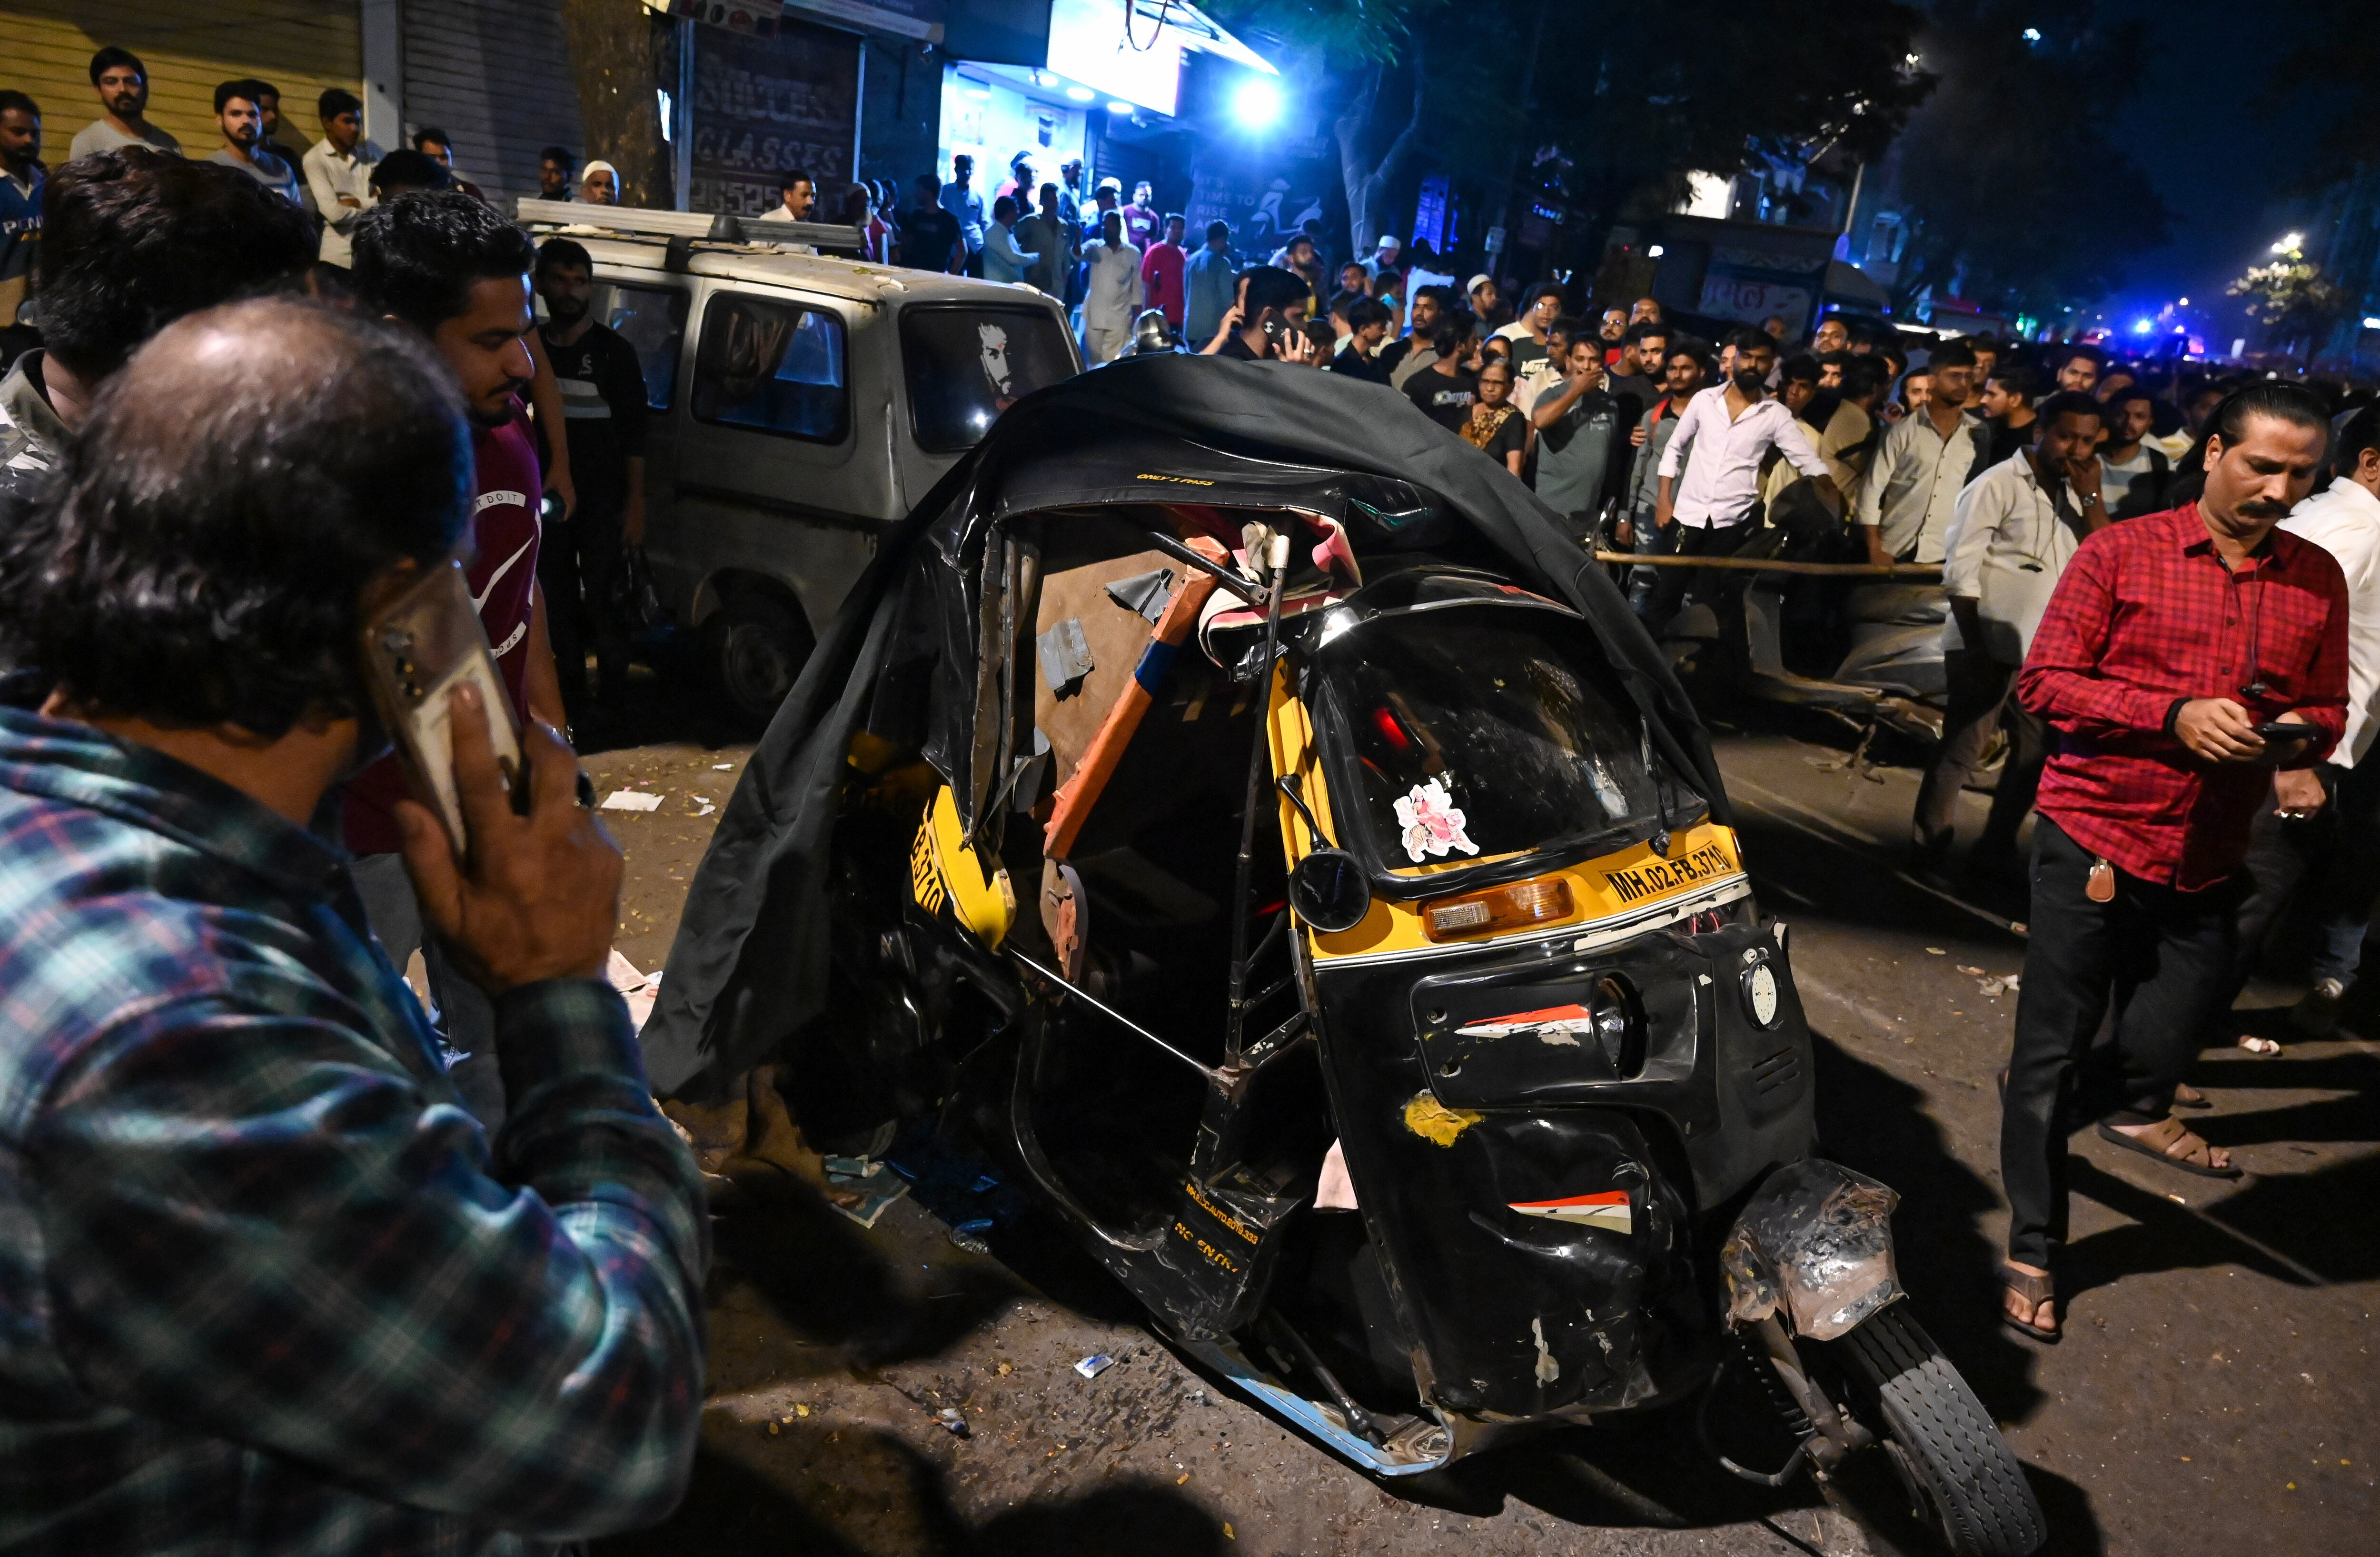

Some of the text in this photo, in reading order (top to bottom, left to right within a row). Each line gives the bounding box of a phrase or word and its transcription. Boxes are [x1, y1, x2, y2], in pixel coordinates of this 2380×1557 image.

[695, 127, 843, 178] CLASSES
[1196, 189, 1255, 207] TIME TO
[1196, 204, 1229, 218] RISE
[486, 493, 503, 504] DO
[508, 492, 517, 502] IT
[1605, 845, 1732, 903] MH.02.FB.3710
